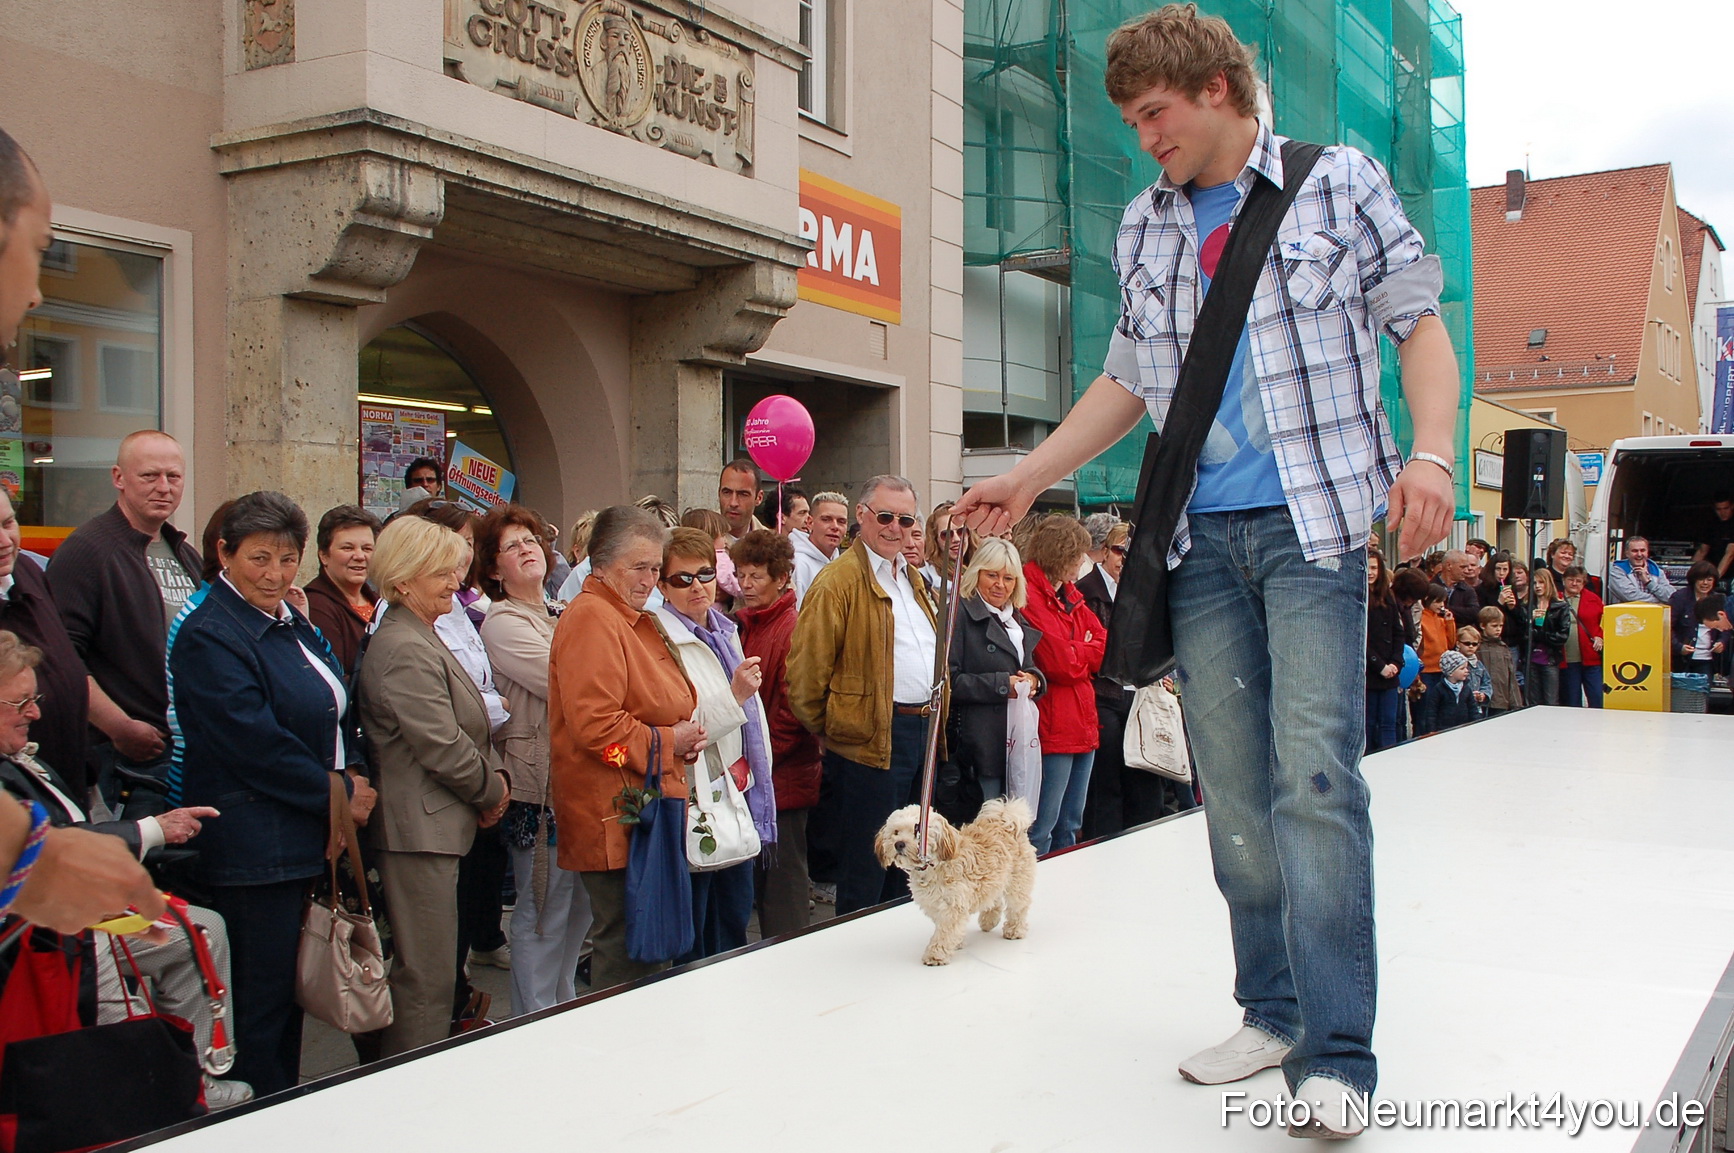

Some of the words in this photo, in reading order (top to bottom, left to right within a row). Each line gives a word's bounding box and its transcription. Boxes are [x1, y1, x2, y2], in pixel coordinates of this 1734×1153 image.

[799, 206, 880, 287] RMA
[363, 410, 394, 420] NORMA
[469, 459, 497, 484] NEUE
